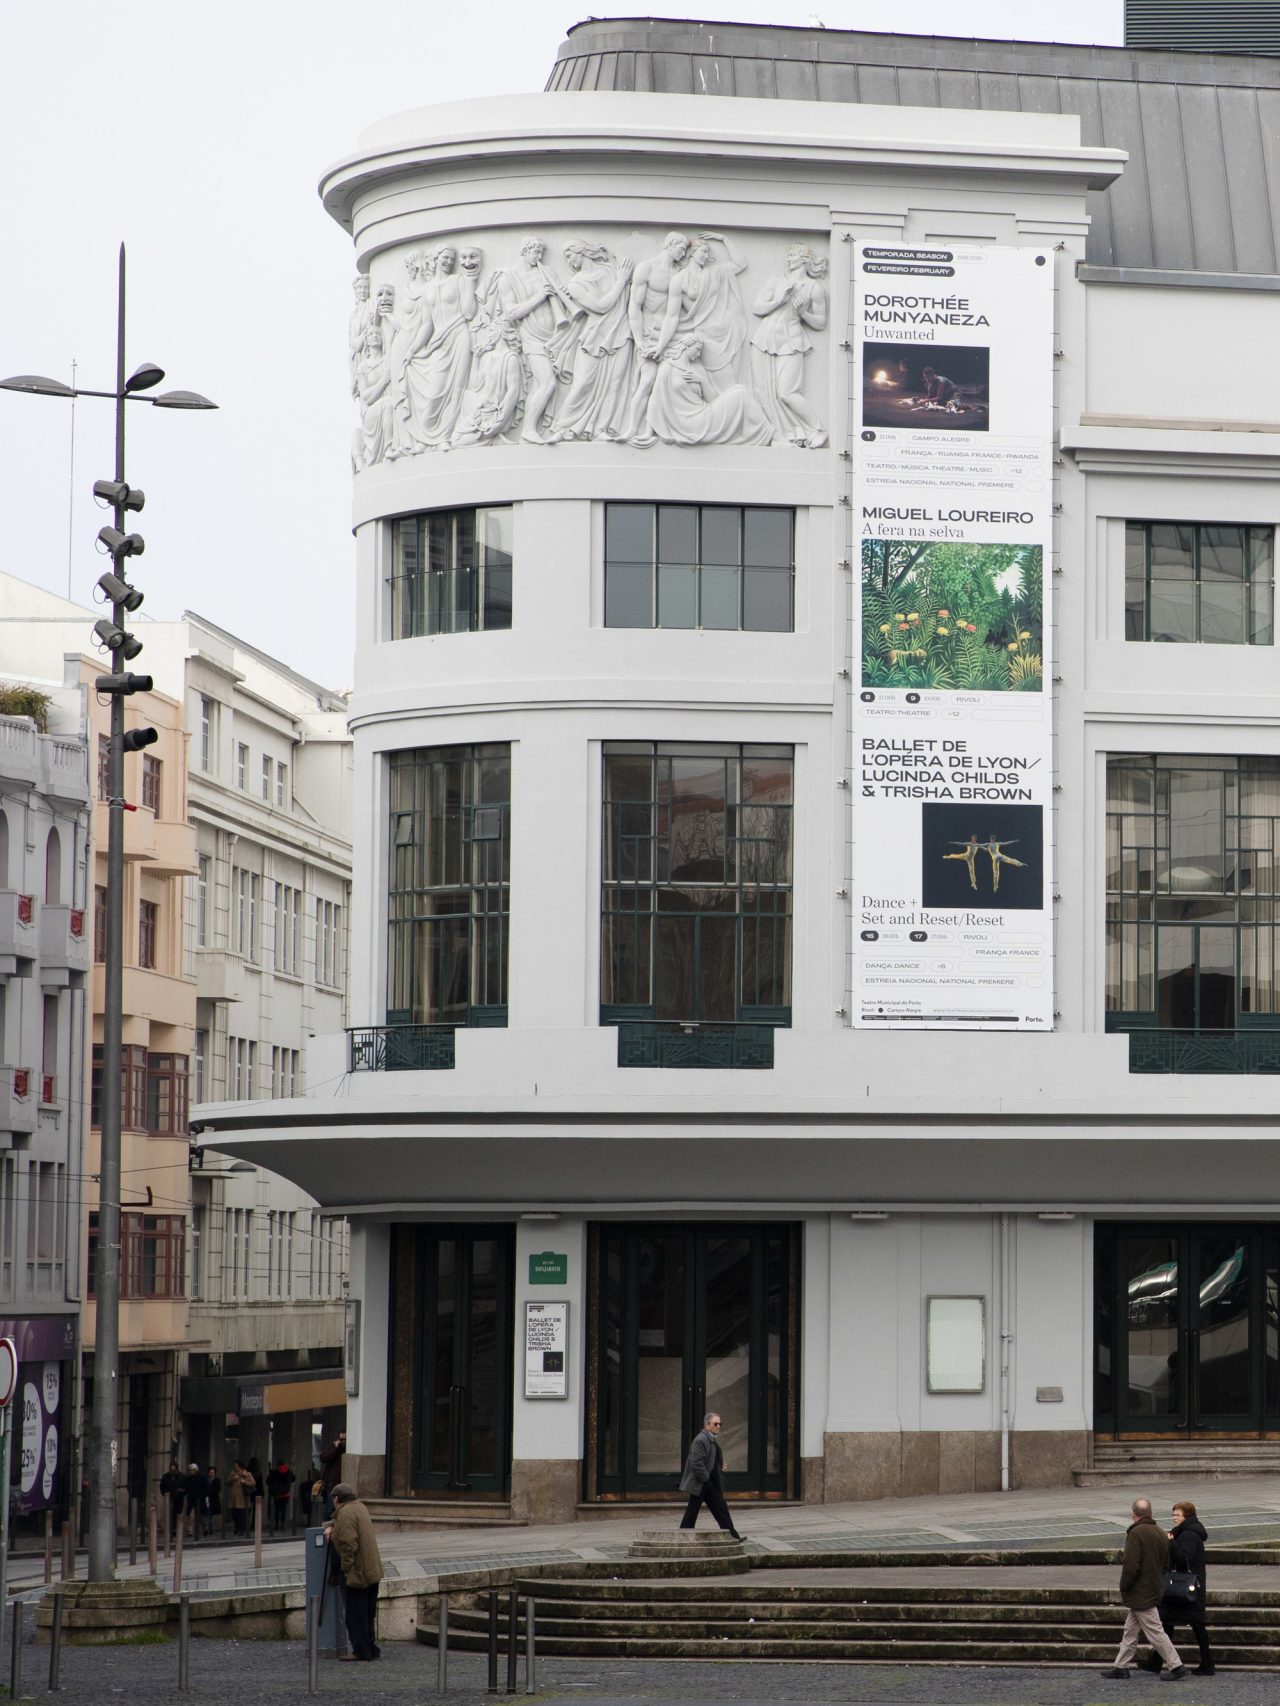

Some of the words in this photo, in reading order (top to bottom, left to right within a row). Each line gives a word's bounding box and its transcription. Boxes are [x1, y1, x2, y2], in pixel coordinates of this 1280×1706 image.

[867, 250, 915, 259] TEMPORADA
[867, 265, 909, 273] FEVEREIRO
[909, 267, 950, 275] FEBRUARY
[864, 294, 970, 311] DOROTHÉE
[864, 310, 991, 327] MUNYANEZA
[864, 325, 935, 341] Unwanted
[862, 506, 934, 521] MIGUEL
[938, 509, 1034, 524] LOUREIRO
[862, 522, 873, 535] A
[877, 523, 904, 536] fera
[908, 526, 926, 537] na
[929, 525, 964, 538] selva
[862, 738, 938, 752] BALLET
[942, 740, 967, 752] DE
[949, 756, 973, 768] DE
[862, 769, 946, 783] LUCINDA
[951, 771, 1020, 785] CHILDS
[862, 785, 876, 797] &
[881, 785, 954, 799] TRISHA
[959, 787, 1032, 800] BROWN
[862, 895, 906, 909] Dance
[910, 898, 918, 907] +
[861, 912, 886, 925] Set
[889, 912, 915, 925] and
[920, 912, 1005, 926] Reset/Reset
[977, 978, 1015, 986] PREMIERE
